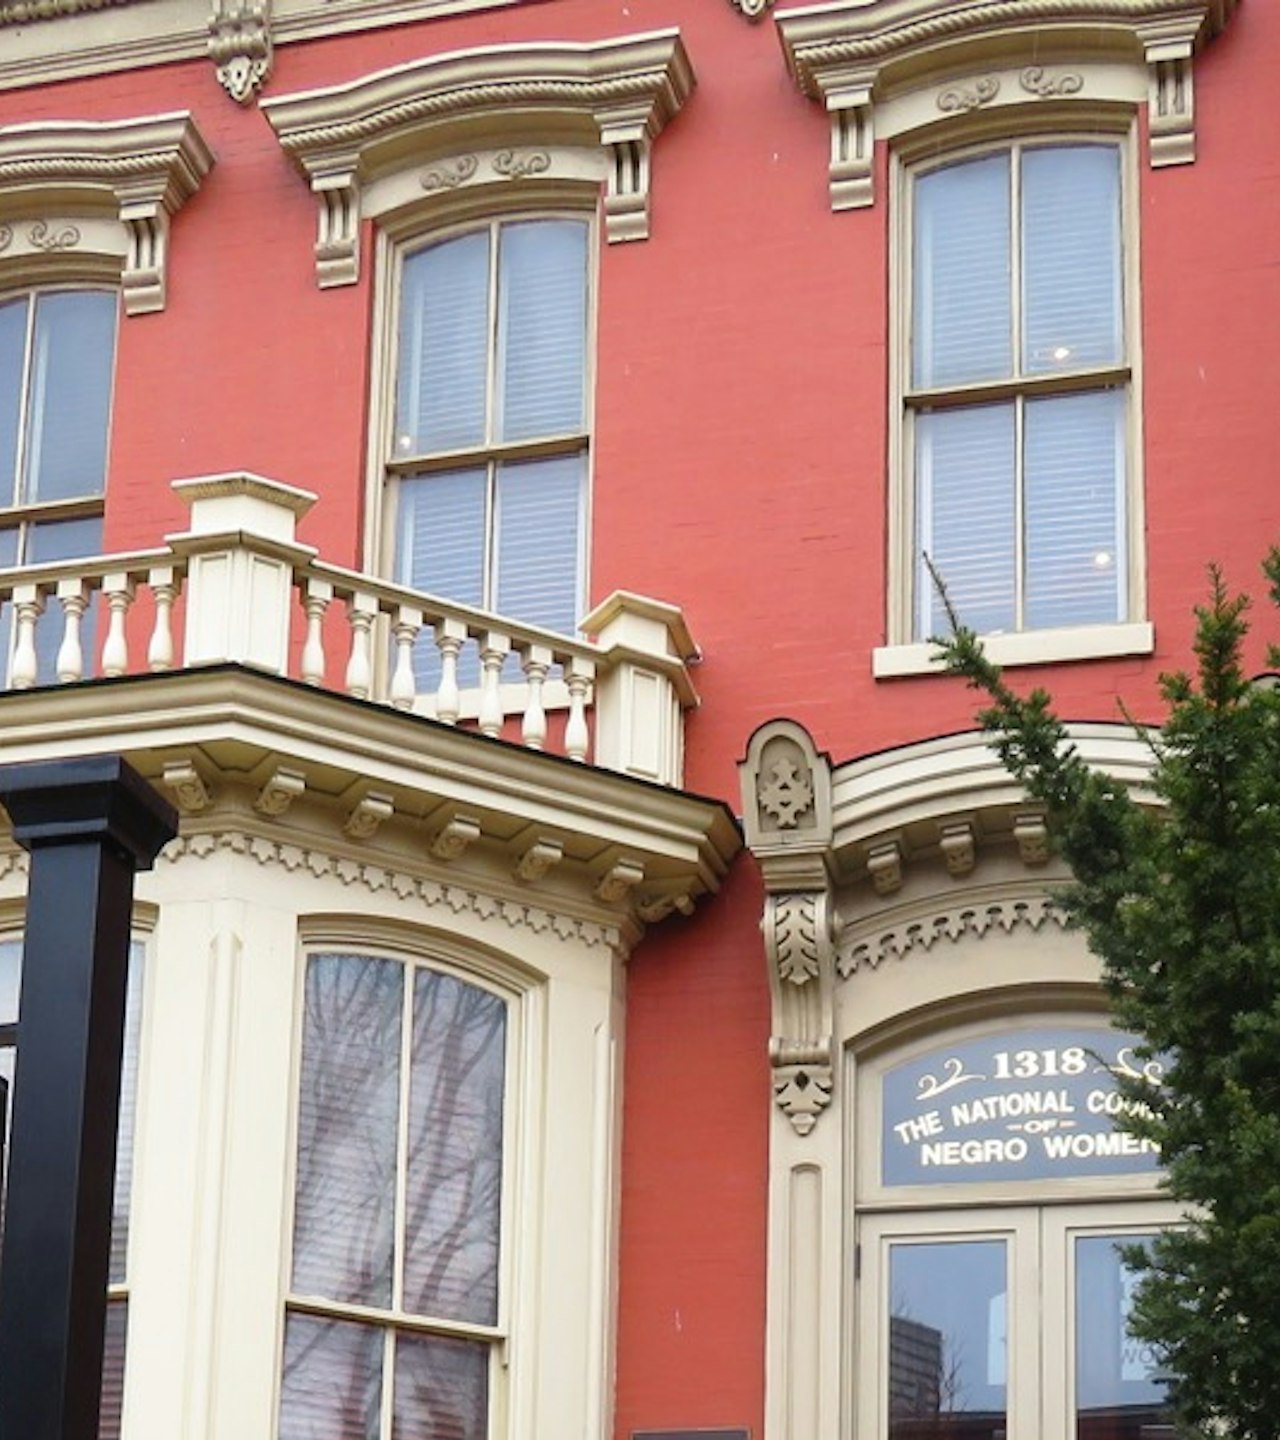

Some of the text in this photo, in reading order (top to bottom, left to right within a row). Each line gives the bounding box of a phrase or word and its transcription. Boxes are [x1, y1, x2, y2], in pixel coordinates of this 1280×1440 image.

[993, 1046, 1087, 1081] 1318
[894, 1089, 1165, 1145] THE NATIONAL COUN
[921, 1132, 1162, 1167] NEGRO WOMEN
